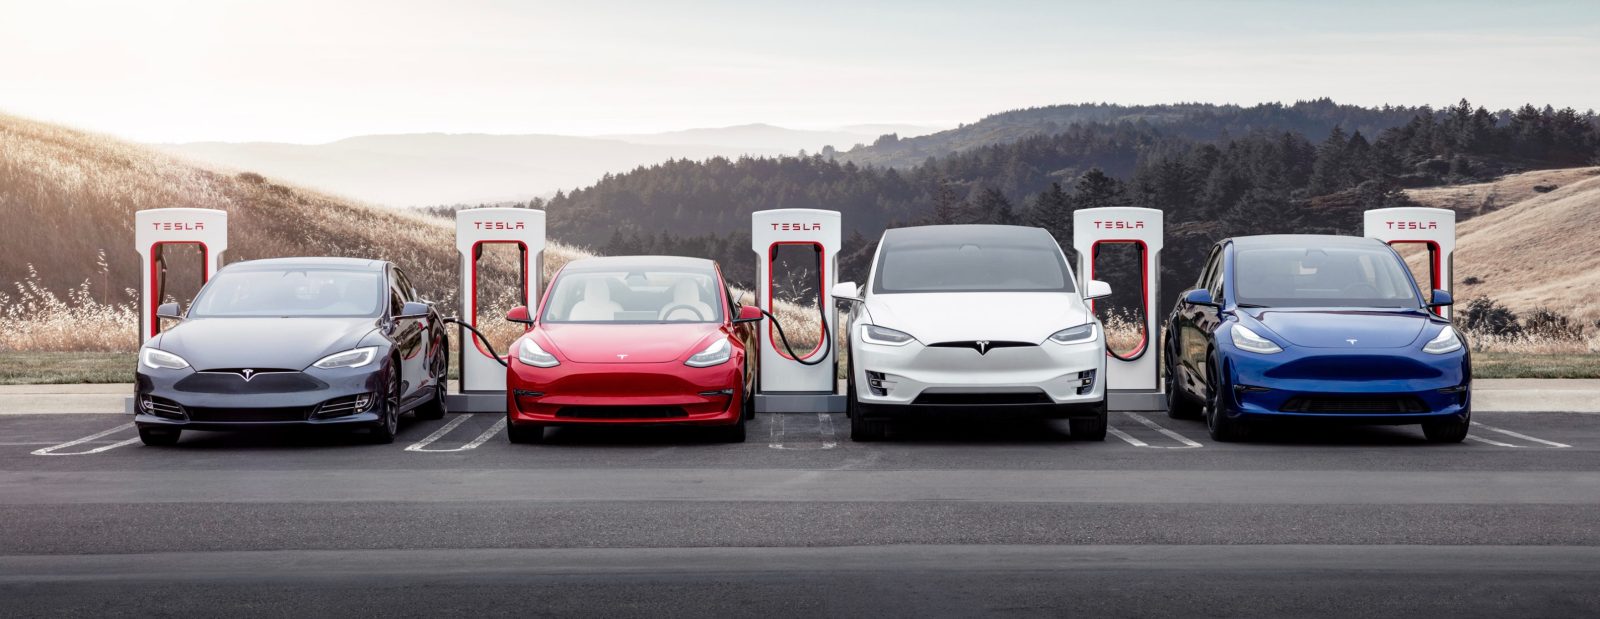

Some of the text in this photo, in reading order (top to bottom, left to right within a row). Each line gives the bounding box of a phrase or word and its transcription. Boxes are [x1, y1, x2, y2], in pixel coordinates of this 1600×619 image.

[152, 222, 204, 231] TESLA
[474, 221, 525, 230] TESLA
[771, 223, 821, 231] TESLA
[1093, 221, 1144, 229] TESLA
[1386, 222, 1437, 230] TESLA
